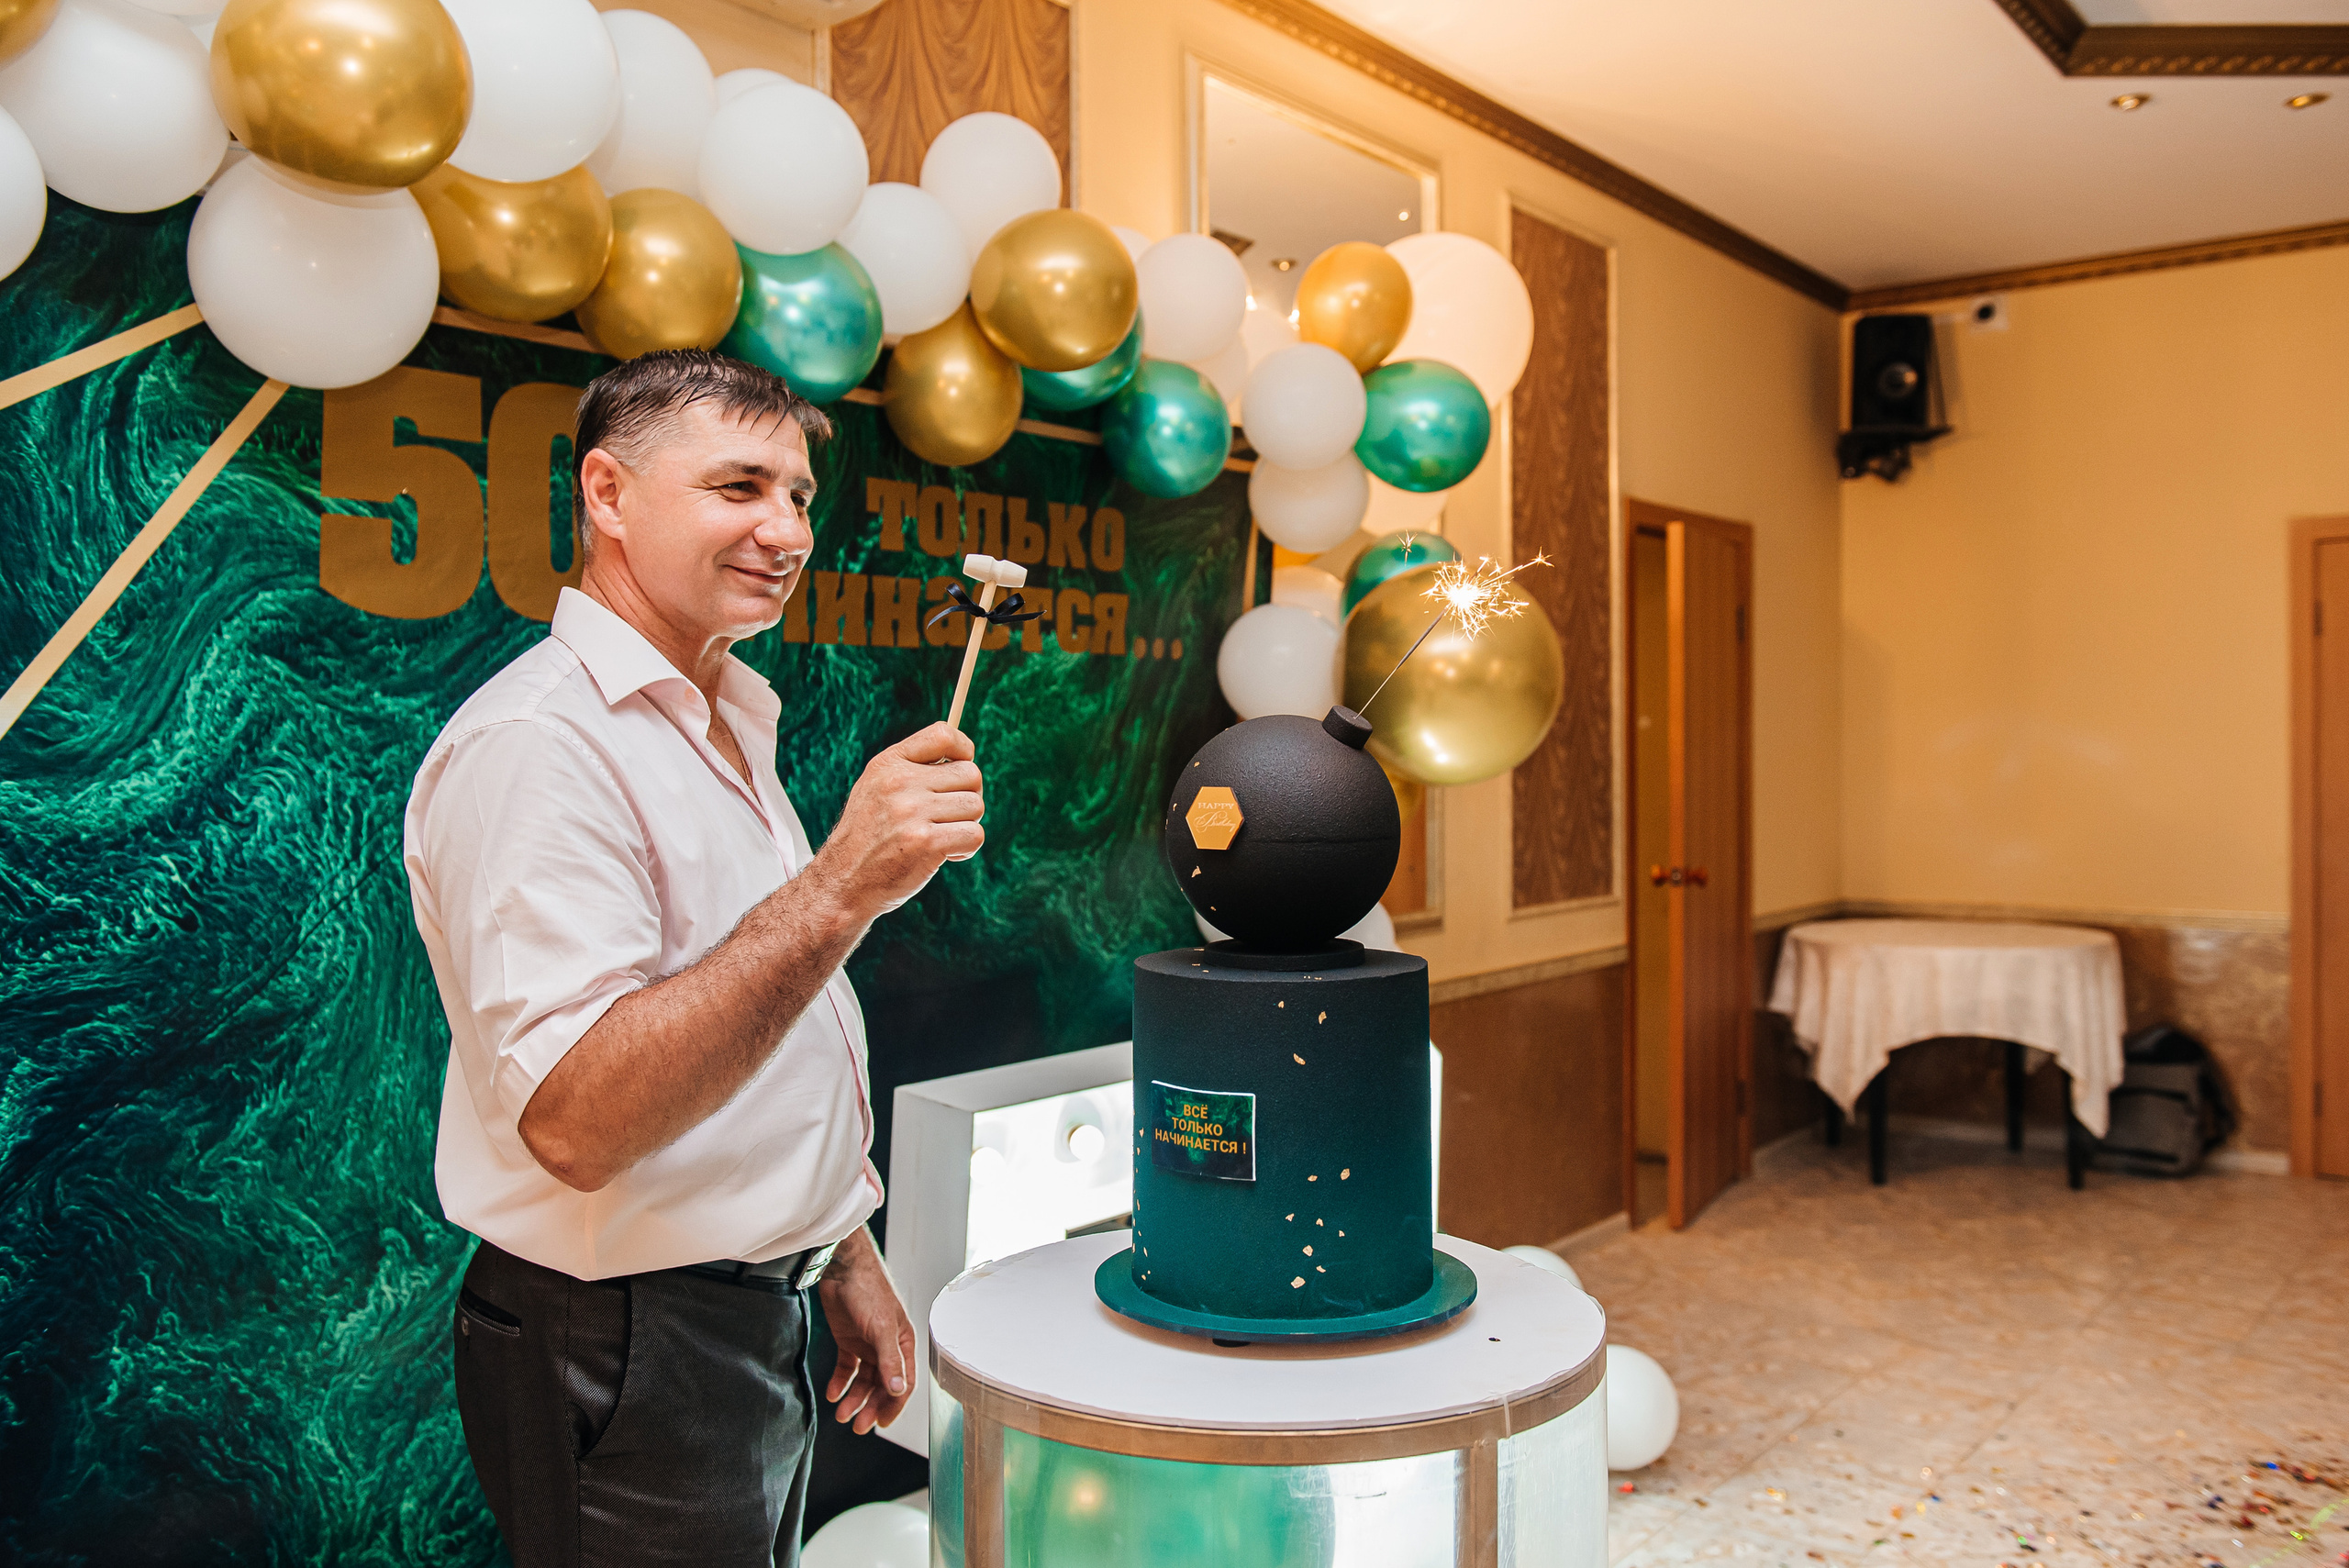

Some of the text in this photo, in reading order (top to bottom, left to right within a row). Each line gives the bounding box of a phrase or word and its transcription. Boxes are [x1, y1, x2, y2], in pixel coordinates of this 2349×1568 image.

[319, 366, 584, 622] 50
[1197, 802, 1235, 810] HAPPY
[1183, 1104, 1208, 1119] ВСЁ
[1171, 1117, 1223, 1137] ТОЛЬКО
[1154, 1128, 1238, 1154] НАЧИНАЕТСЯ
